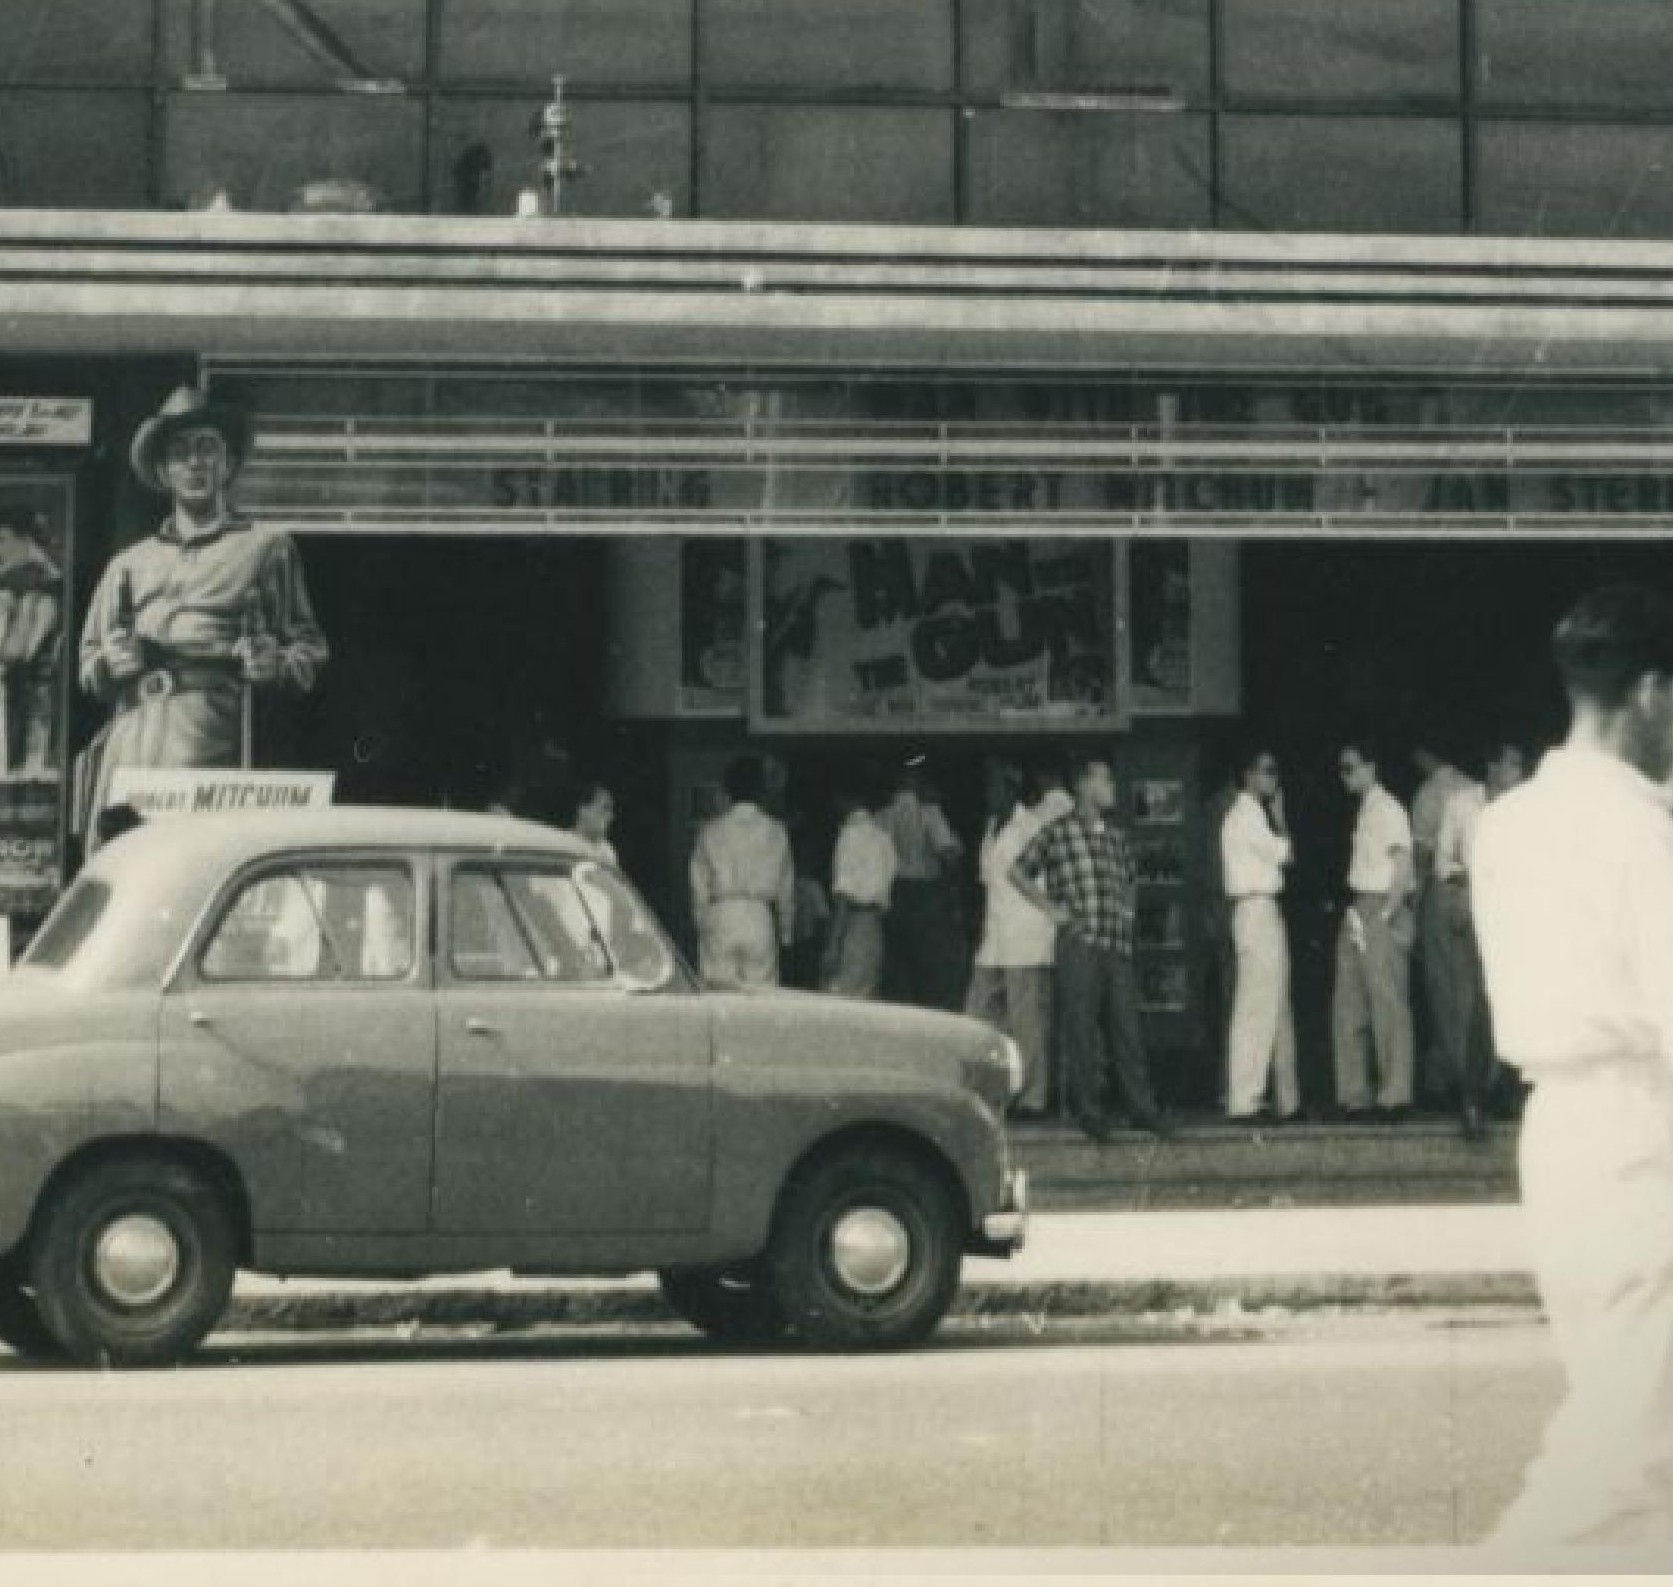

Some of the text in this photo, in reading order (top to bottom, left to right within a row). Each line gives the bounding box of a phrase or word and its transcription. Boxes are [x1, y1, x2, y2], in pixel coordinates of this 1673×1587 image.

[493, 468, 711, 507] STARRING
[868, 471, 1064, 510] ROBERT
[1103, 472, 1316, 512] MITCHUM
[1419, 474, 1510, 512] JAN
[848, 539, 1031, 629] MAN
[911, 590, 1098, 682] GUN
[192, 782, 312, 812] MITCHUM
